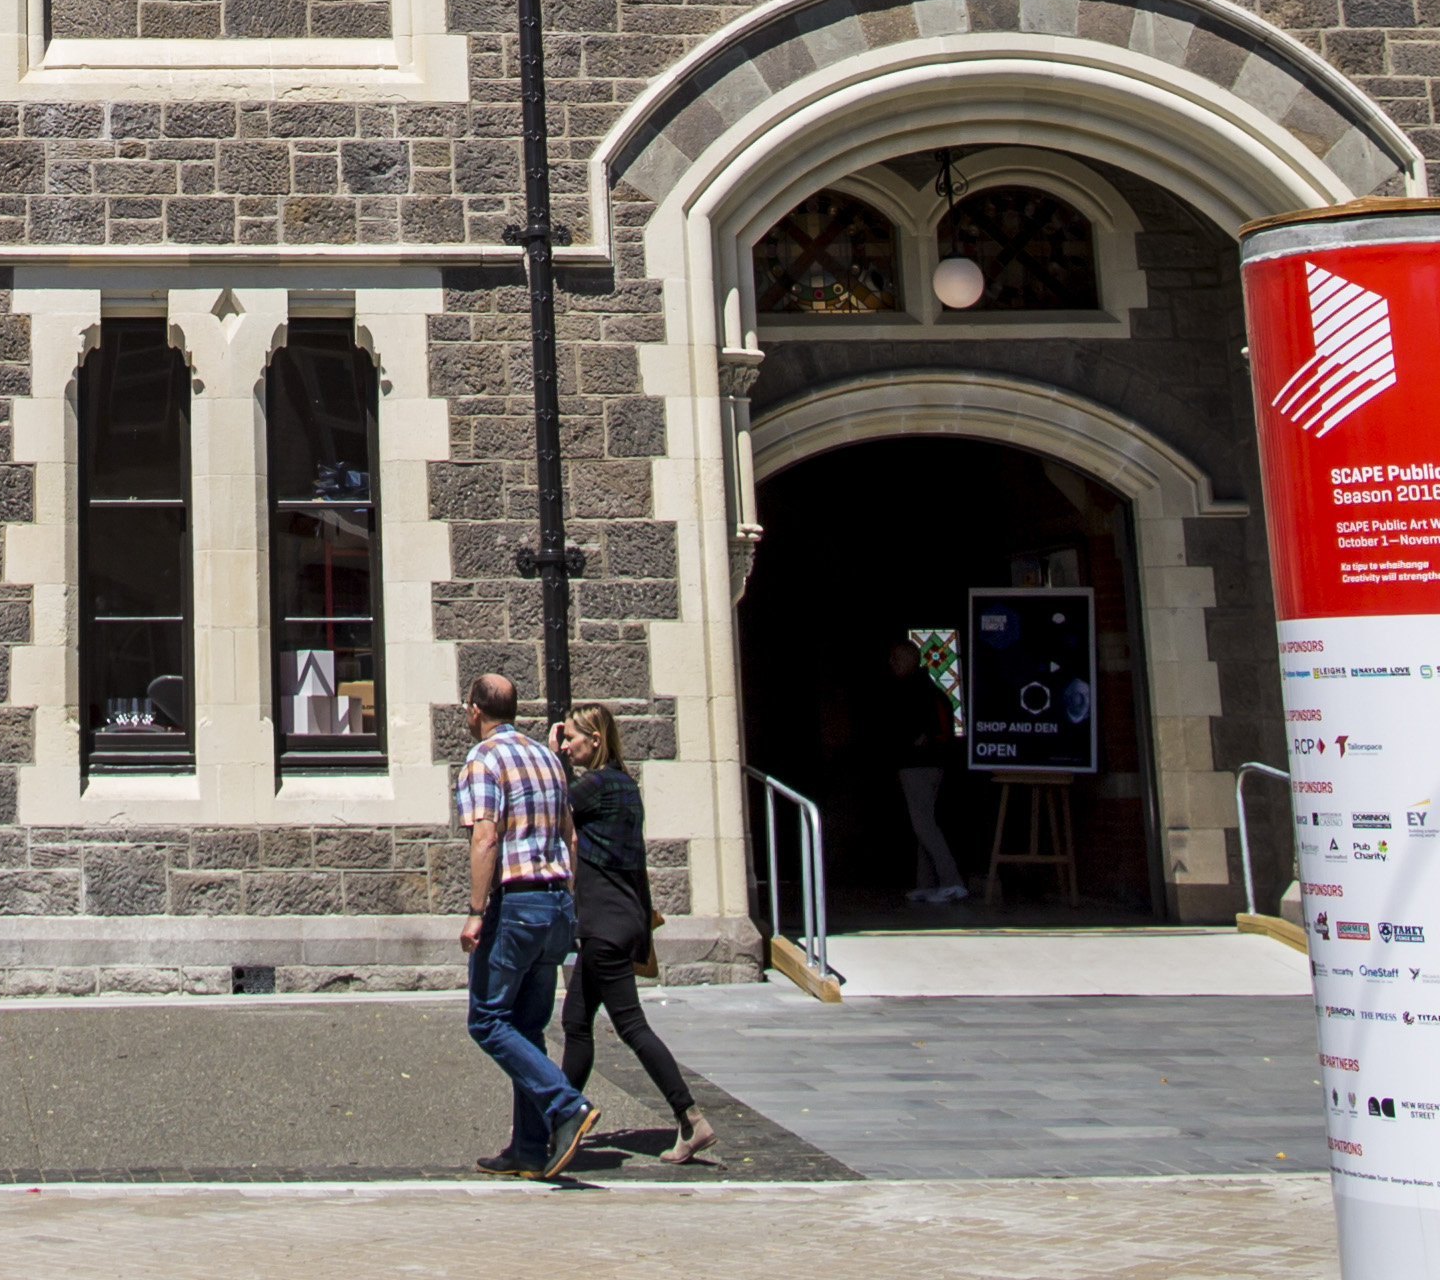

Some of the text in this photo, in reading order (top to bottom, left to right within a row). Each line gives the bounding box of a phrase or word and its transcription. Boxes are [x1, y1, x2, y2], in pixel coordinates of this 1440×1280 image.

[1331, 466, 1384, 484] SCAPE
[1333, 488, 1392, 505] Season
[1336, 520, 1369, 533] SCAPE
[1372, 520, 1407, 532] Public
[1410, 519, 1428, 530] Art
[1338, 536, 1378, 548] October
[1342, 574, 1380, 584] Creativity
[1382, 573, 1397, 581] will
[1287, 640, 1324, 653] SPONSORS
[976, 721, 1058, 733] SHOP AND DEN
[976, 743, 1017, 756] OPEN
[1295, 738, 1314, 754] RCP
[1298, 781, 1334, 794] SPONSORS
[1352, 813, 1390, 822] DOMINION
[1406, 811, 1427, 826] EY
[1353, 842, 1370, 851] Pub
[1354, 851, 1387, 862] Charity
[1308, 883, 1343, 897] SPONSORS
[1359, 964, 1399, 978] OneStaff
[1360, 1011, 1397, 1021] THE PRESS
[1326, 1055, 1360, 1072] PARTNERS
[1401, 1101, 1416, 1109] NEW
[1410, 1111, 1435, 1120] STREET
[1334, 1140, 1363, 1156] PATRONS
